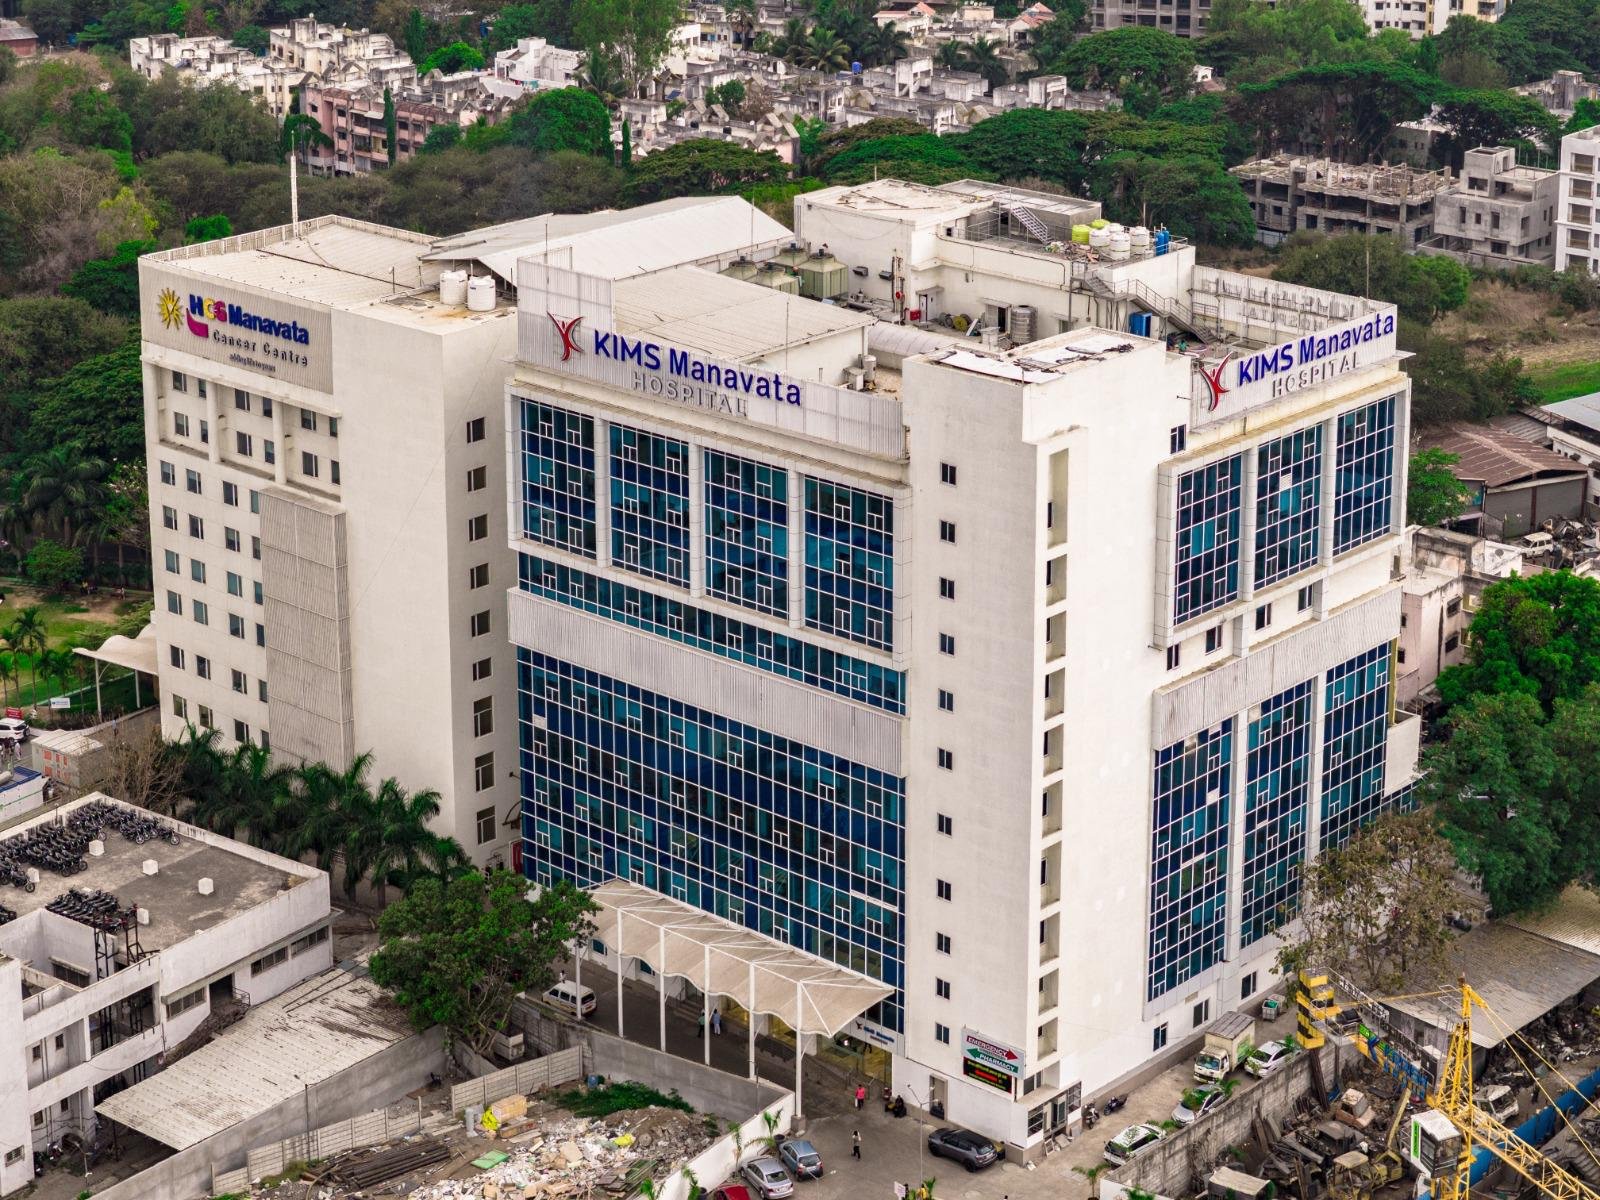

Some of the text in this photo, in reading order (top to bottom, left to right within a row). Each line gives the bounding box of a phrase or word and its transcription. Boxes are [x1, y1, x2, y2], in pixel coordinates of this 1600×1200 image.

[189, 294, 310, 345] HCG Manavata
[213, 329, 308, 367] Cancer Centre
[594, 329, 801, 406] KIMS Manavata
[1238, 313, 1394, 387] KIMS Manavata
[633, 371, 749, 417] HOSPITAL
[1272, 351, 1360, 398] HOSPITAL
[980, 1053, 1015, 1072] PHARMACY
